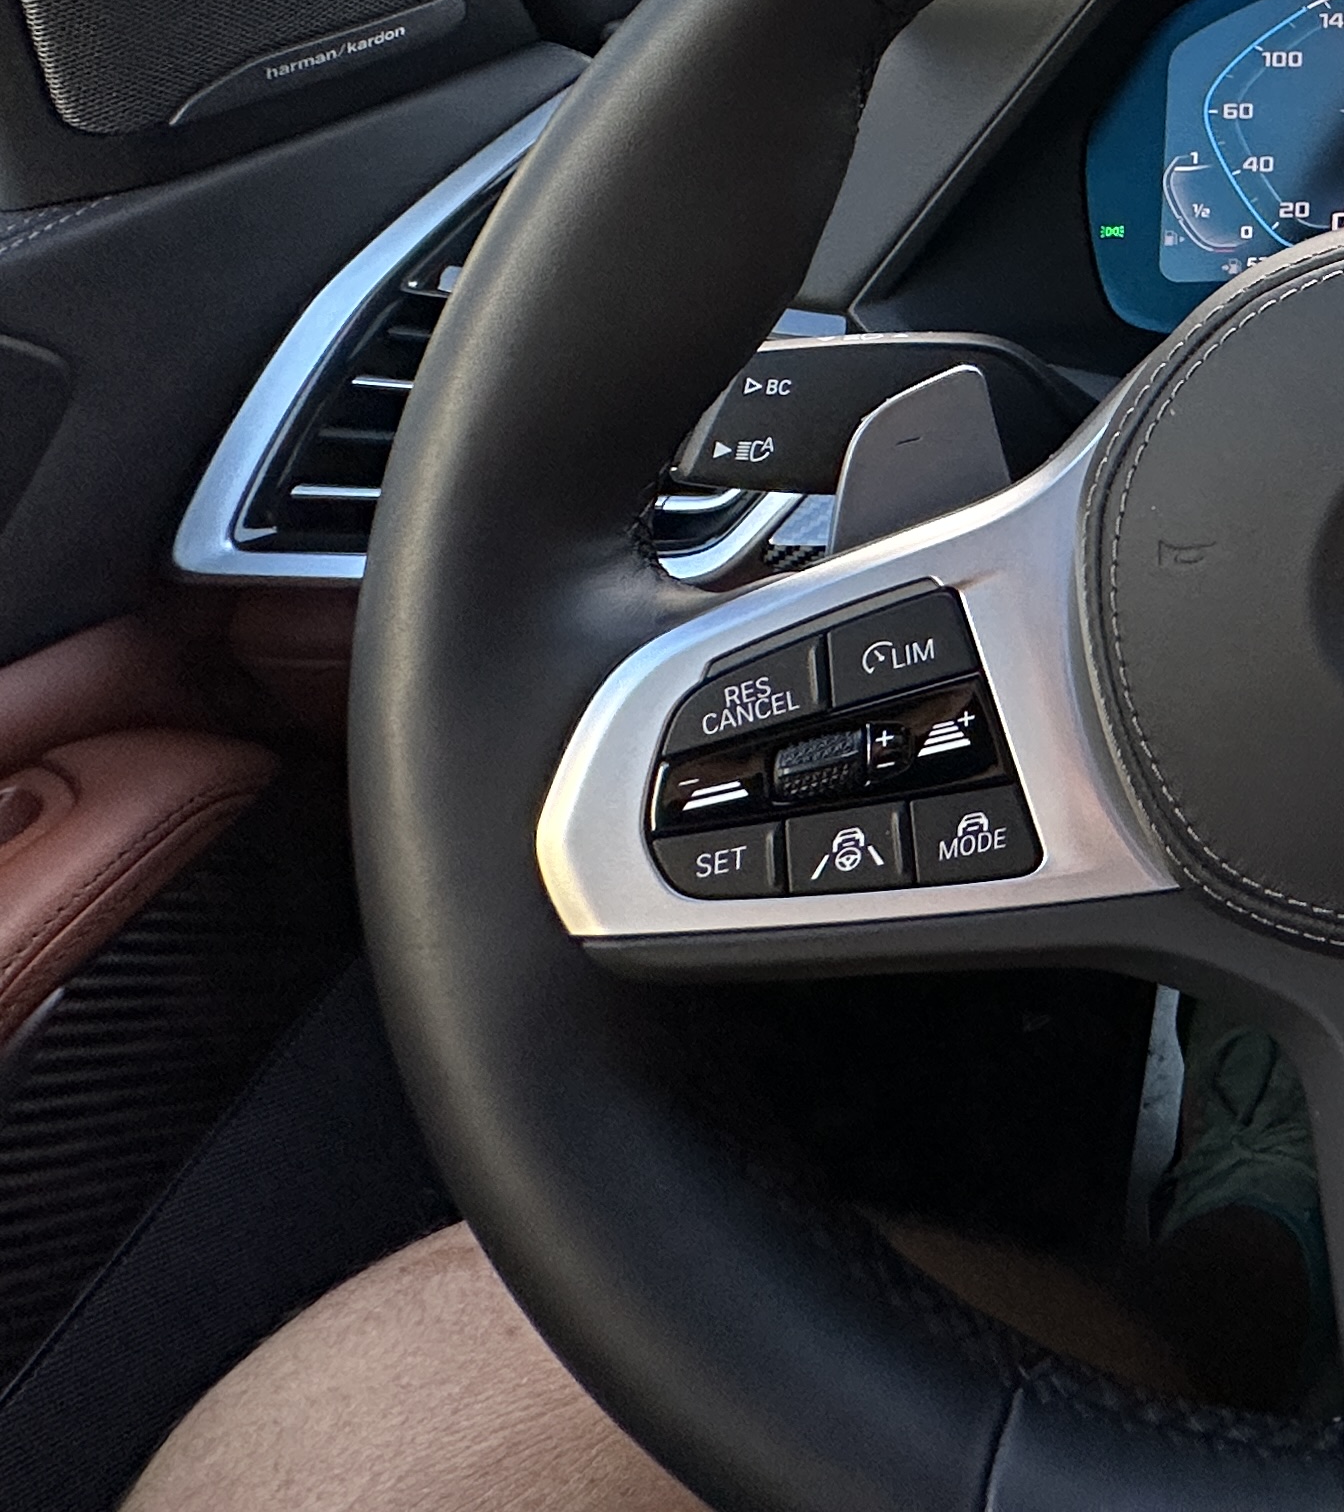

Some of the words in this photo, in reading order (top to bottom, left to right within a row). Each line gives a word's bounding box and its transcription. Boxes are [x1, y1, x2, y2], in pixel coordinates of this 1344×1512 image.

[266, 25, 406, 80] harman/kardon
[1261, 51, 1303, 68] 100
[1222, 103, 1254, 119] 60
[1190, 151, 1199, 165] 1
[1243, 156, 1274, 172] 40
[1279, 202, 1310, 218] 20
[1240, 225, 1253, 239] 0
[765, 379, 792, 396] BC
[891, 638, 935, 670] LIM
[724, 676, 772, 708] RES
[702, 691, 800, 736] CANCEL
[938, 828, 1008, 862] MODE
[695, 845, 748, 879] SET
